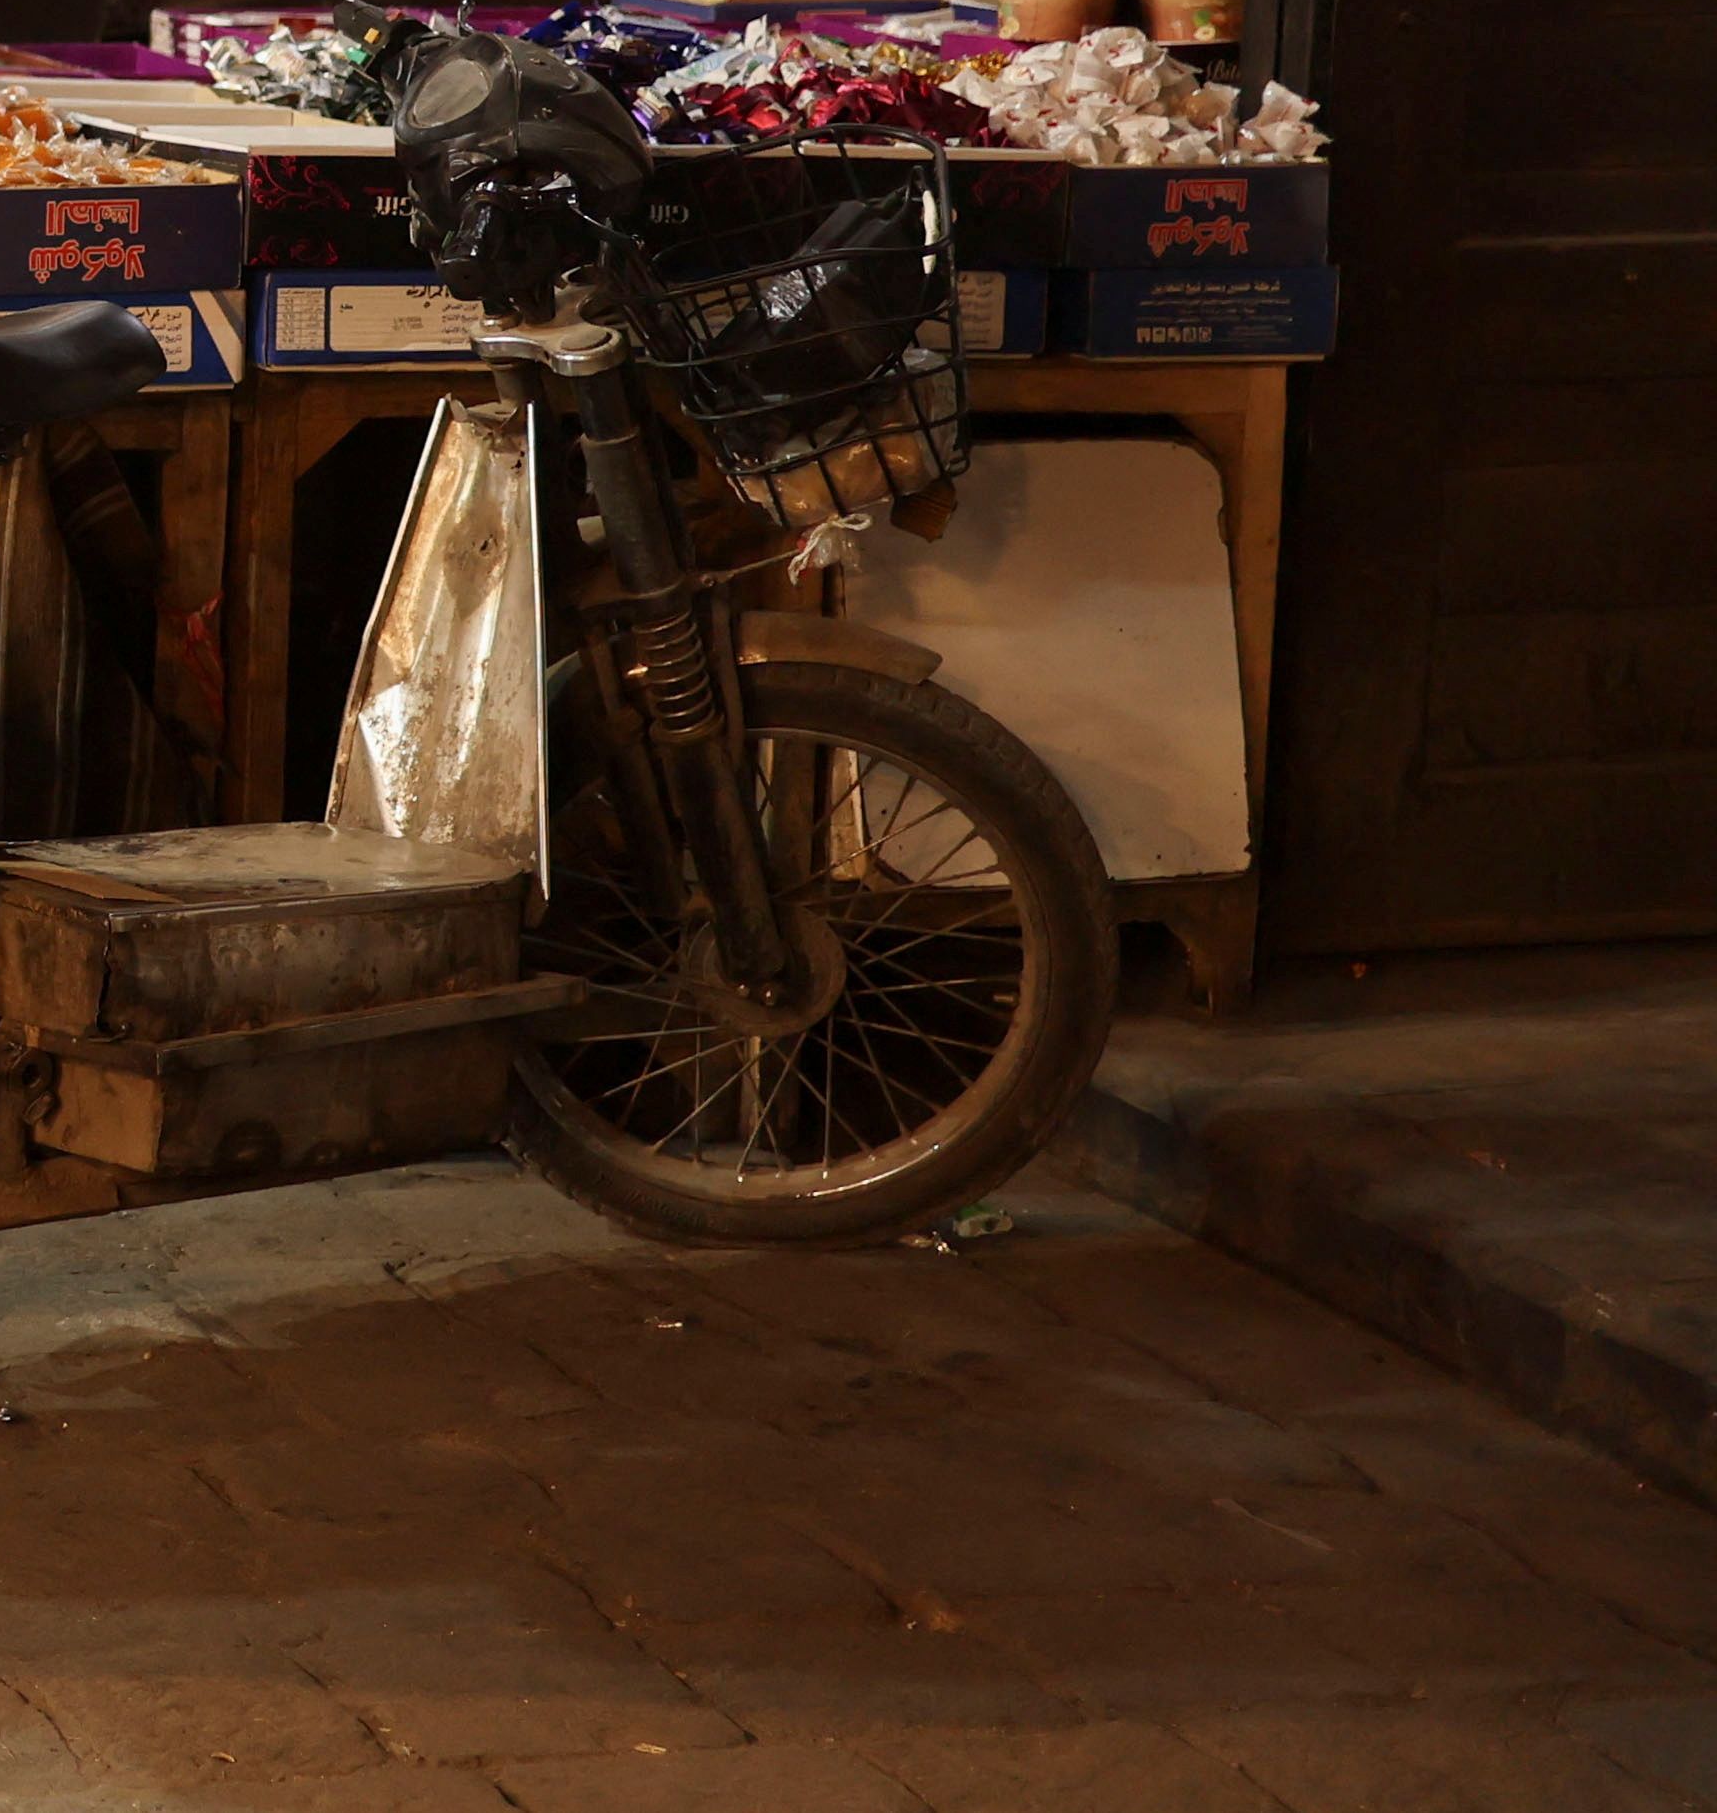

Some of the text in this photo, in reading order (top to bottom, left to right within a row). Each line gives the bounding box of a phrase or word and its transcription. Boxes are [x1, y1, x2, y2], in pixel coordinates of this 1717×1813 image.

[46, 199, 140, 235] الهنا
[374, 196, 417, 218] Gift
[1148, 217, 1249, 258] شوكولا
[28, 237, 146, 284] شوكولا
